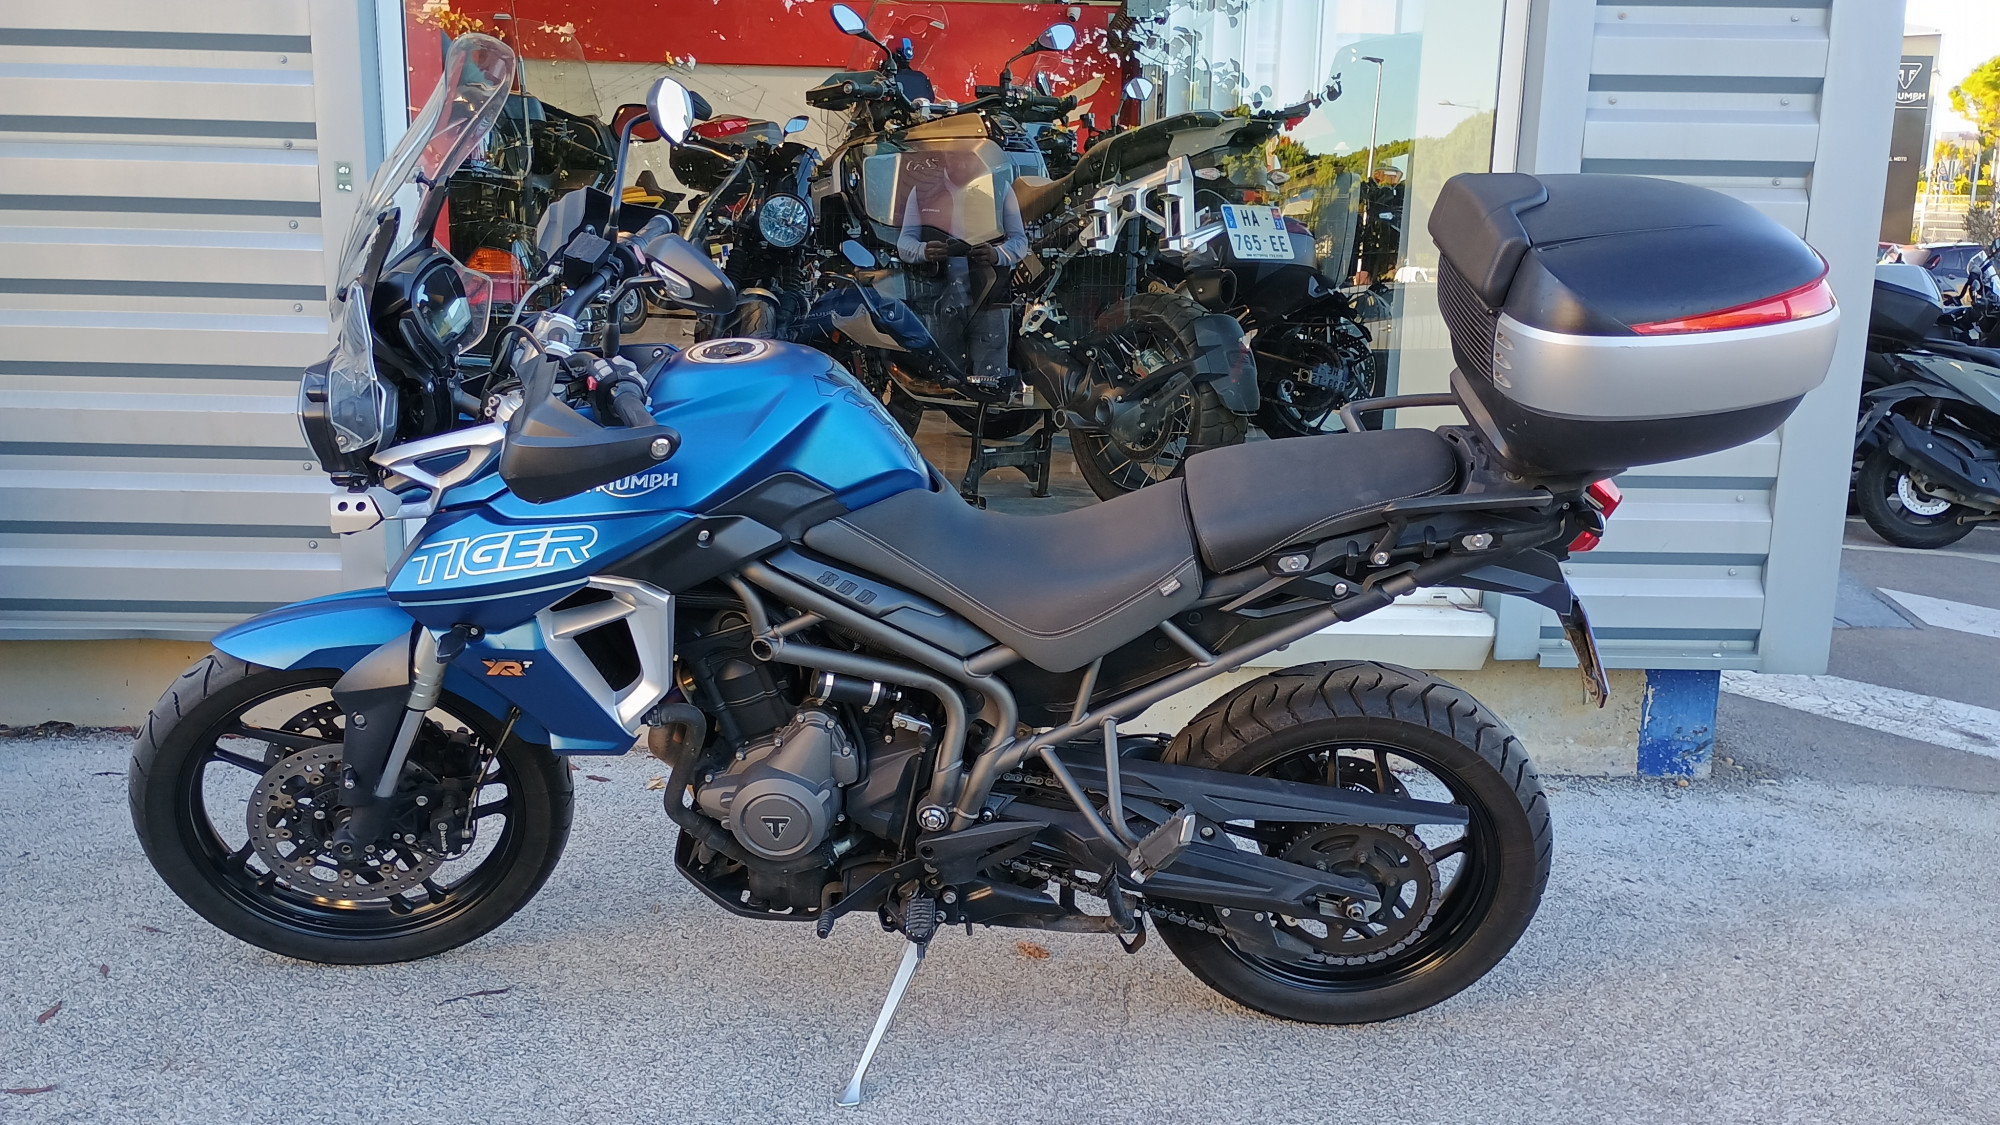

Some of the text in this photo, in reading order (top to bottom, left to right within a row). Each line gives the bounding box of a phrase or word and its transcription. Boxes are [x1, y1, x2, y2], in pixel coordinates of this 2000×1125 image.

[1897, 92, 1926, 100] UMPH
[1233, 233, 1289, 253] 765-EE
[411, 525, 598, 585] TIGER
[816, 570, 878, 606] 800
